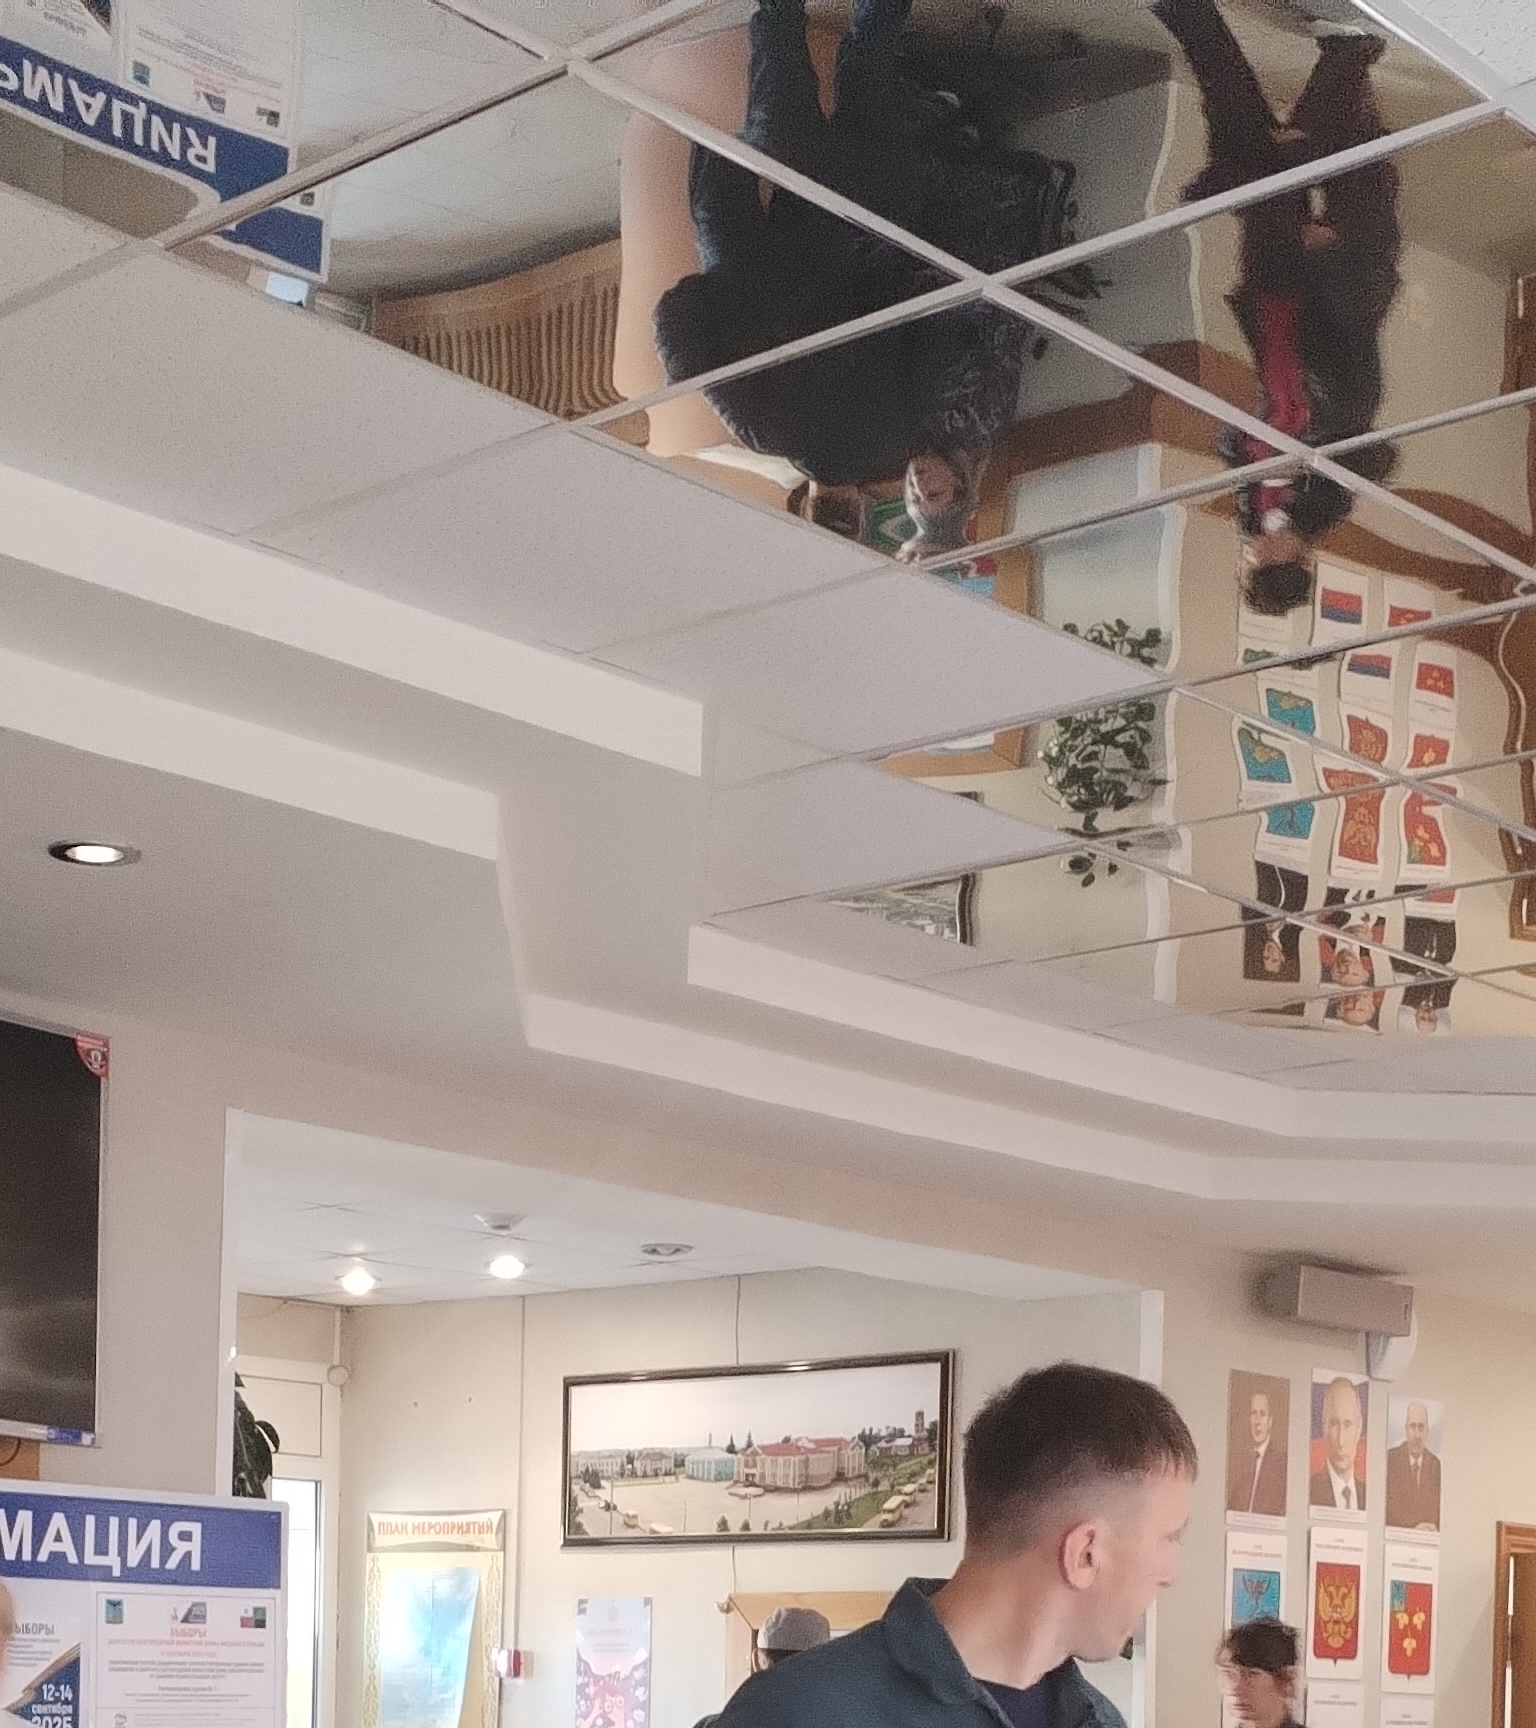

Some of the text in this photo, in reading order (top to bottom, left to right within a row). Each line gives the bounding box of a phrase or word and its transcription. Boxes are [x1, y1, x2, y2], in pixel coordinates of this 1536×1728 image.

[378, 1517, 493, 1535] ПЛАН МЕРОПРИЯТИЙ
[14, 1623, 55, 1636] ЫБОРЫ
[42, 1683, 73, 1702] 12-14
